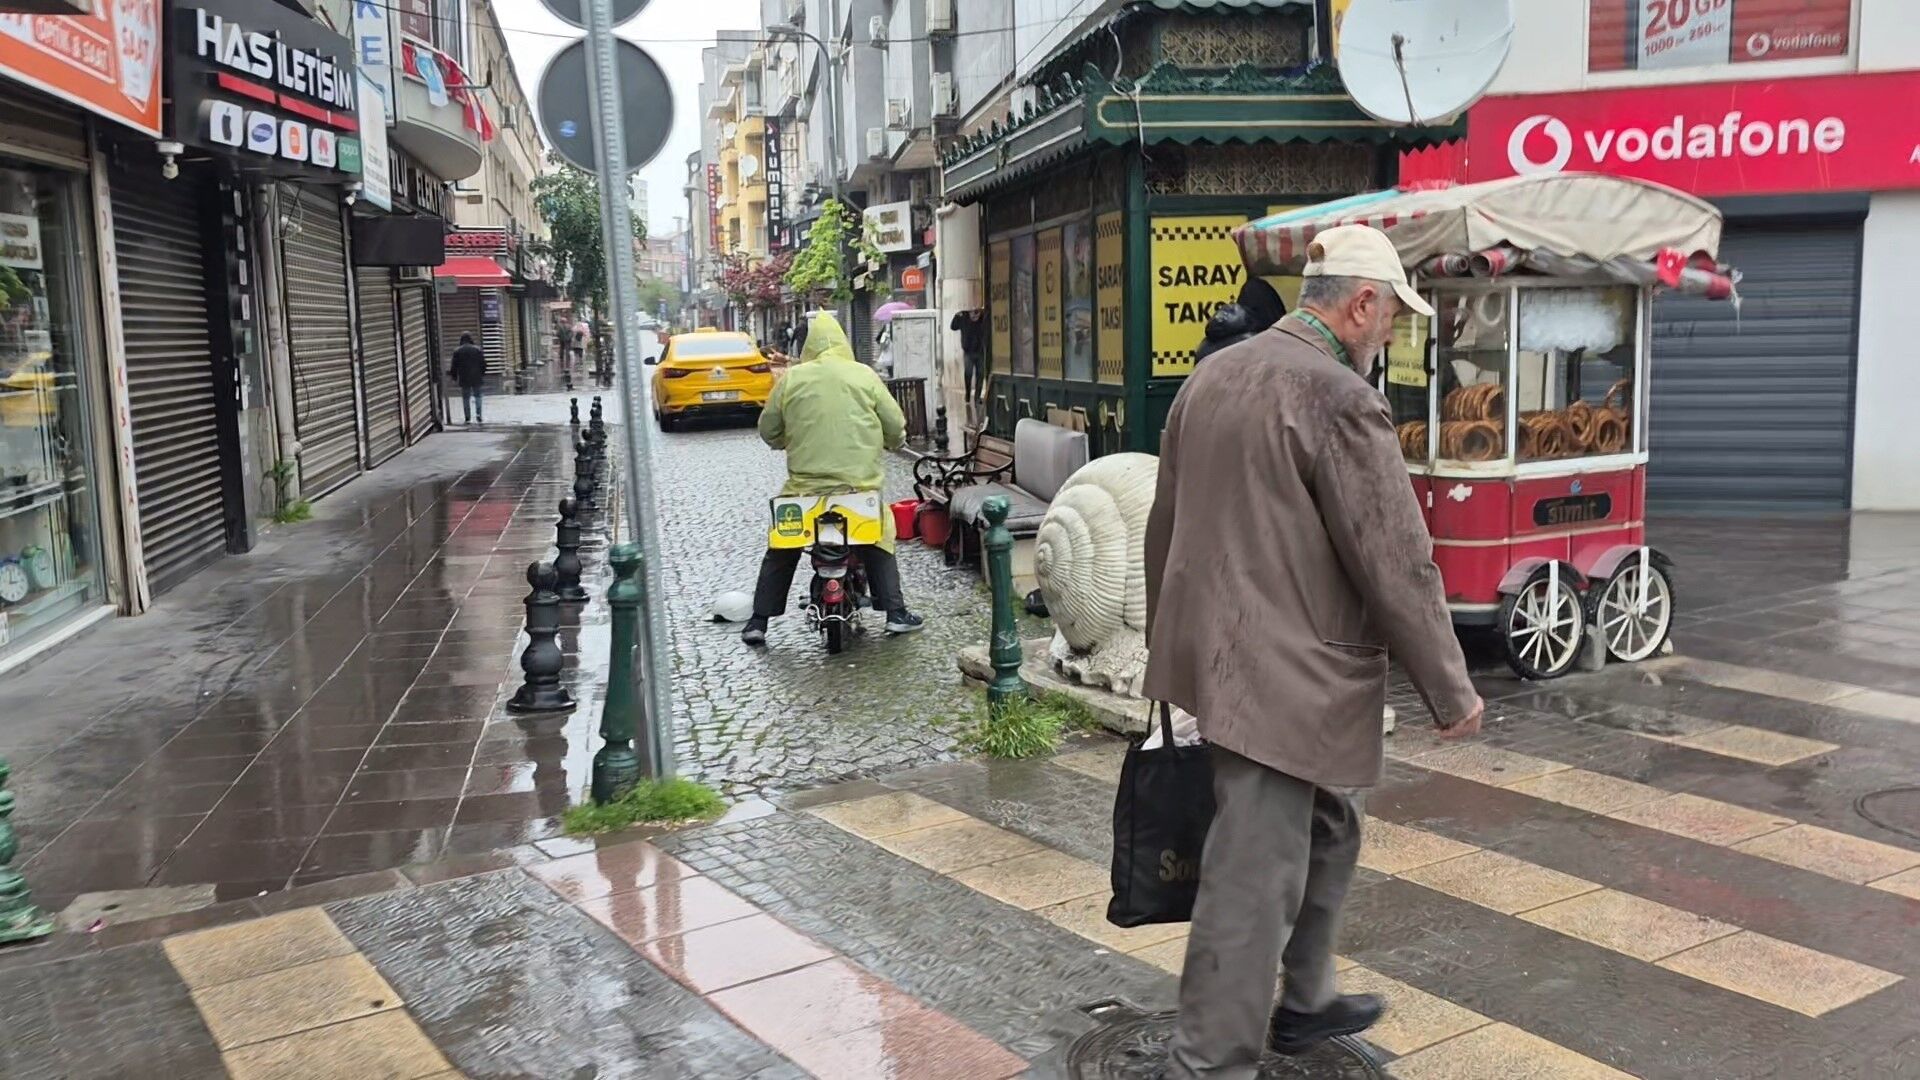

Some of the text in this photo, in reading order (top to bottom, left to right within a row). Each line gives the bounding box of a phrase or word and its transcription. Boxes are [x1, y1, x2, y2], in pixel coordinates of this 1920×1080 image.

[1645, 0, 1691, 39] 20
[197, 8, 273, 79] HAS
[1644, 36, 1674, 57] 1000
[1772, 32, 1842, 50] vodafone
[1583, 110, 1846, 164] vodafone
[1159, 264, 1242, 287] SARAY
[1158, 849, 1200, 882] So
